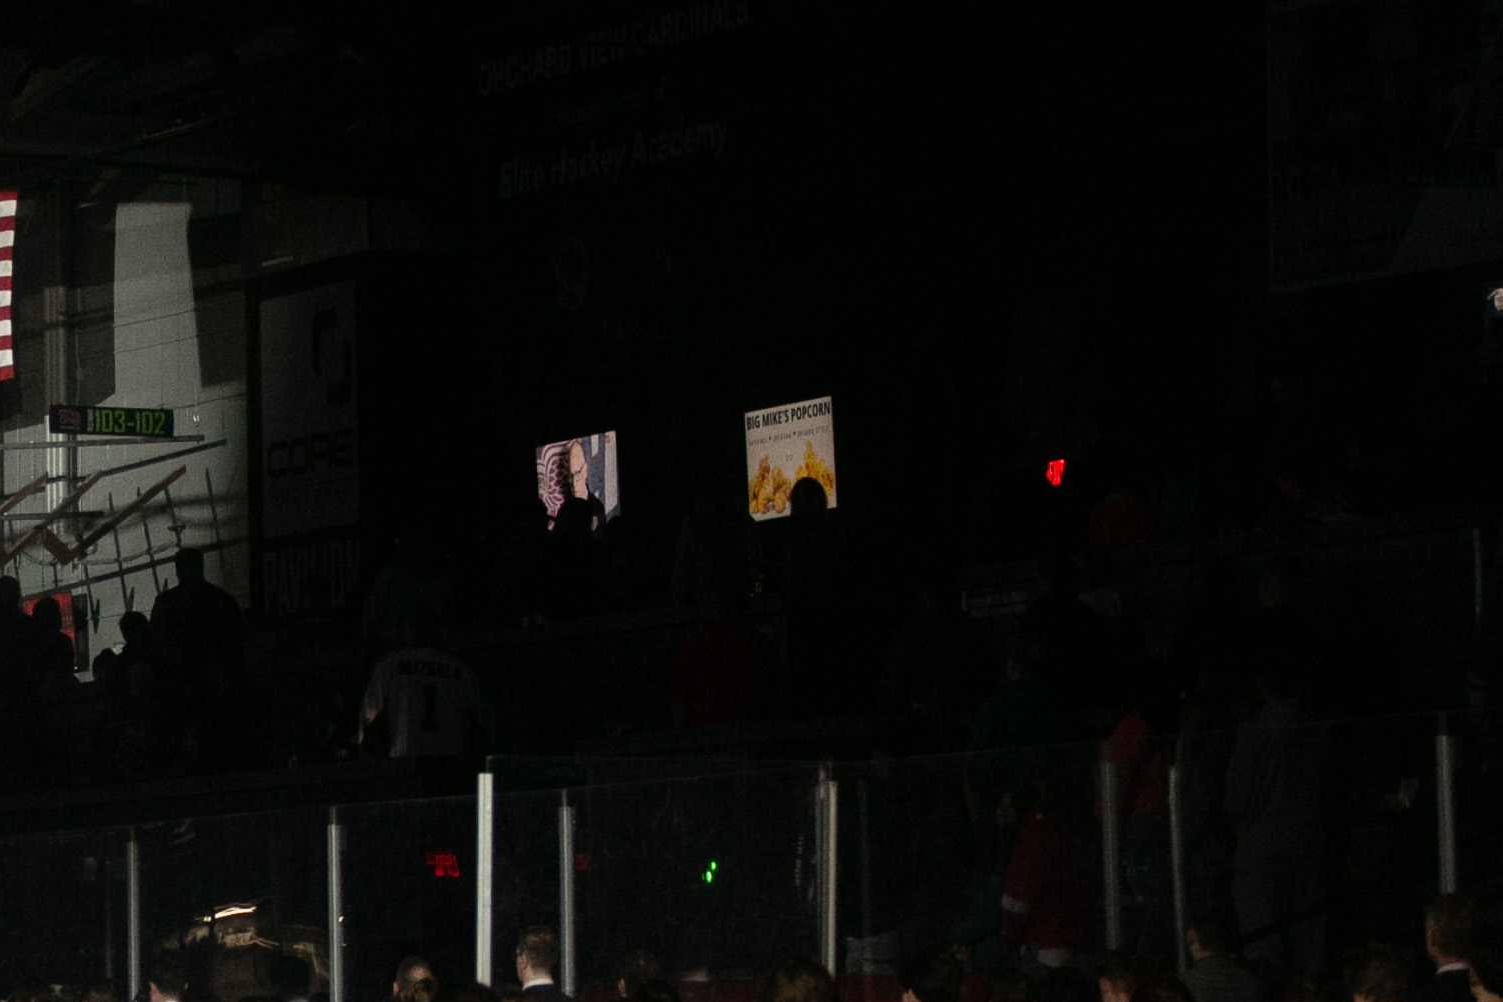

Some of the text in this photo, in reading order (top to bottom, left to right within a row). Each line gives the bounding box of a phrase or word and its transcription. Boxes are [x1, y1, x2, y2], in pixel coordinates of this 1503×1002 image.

[95, 409, 166, 434] 103-102
[746, 401, 831, 430] BIG MIKE'S POPCORN
[267, 430, 355, 479] CORE
